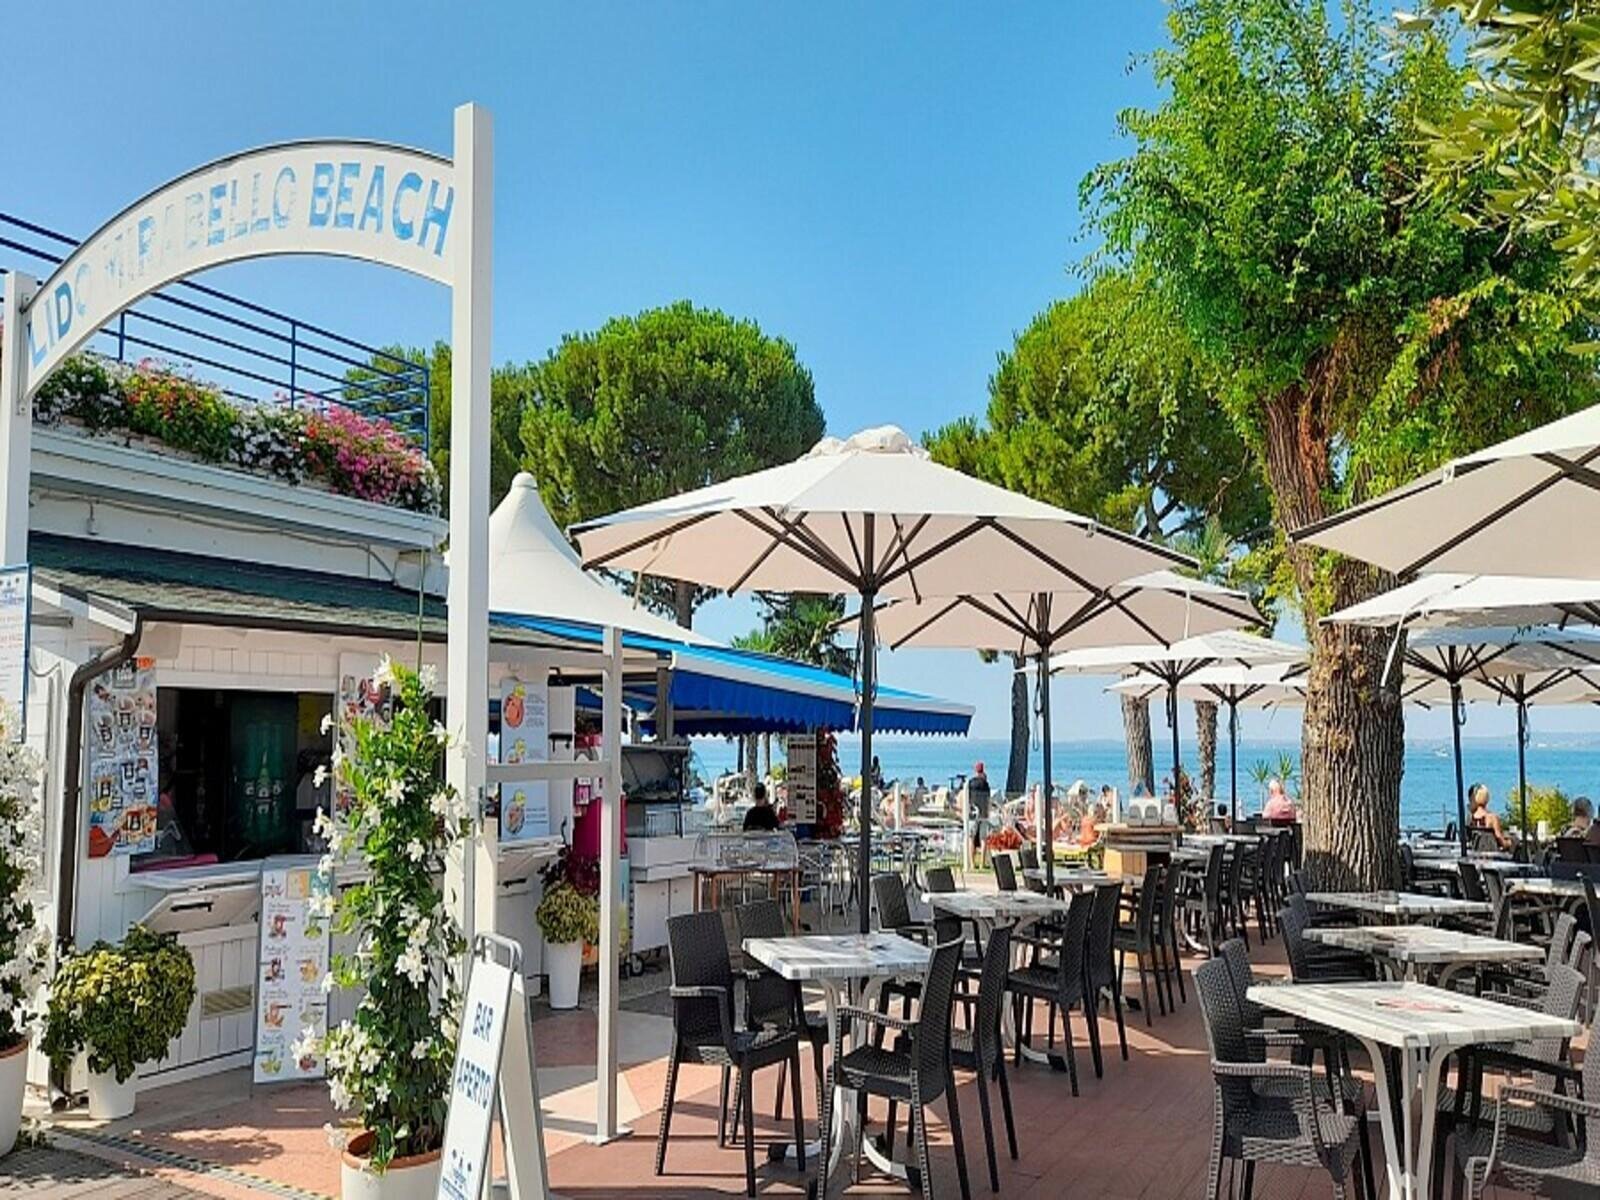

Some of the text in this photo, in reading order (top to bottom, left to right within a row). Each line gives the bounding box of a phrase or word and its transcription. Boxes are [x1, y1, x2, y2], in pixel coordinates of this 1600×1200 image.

[27, 162, 454, 369] LIDO RBELLO BEACH
[473, 1001, 493, 1042] BAR
[457, 1057, 491, 1109] APERTO
